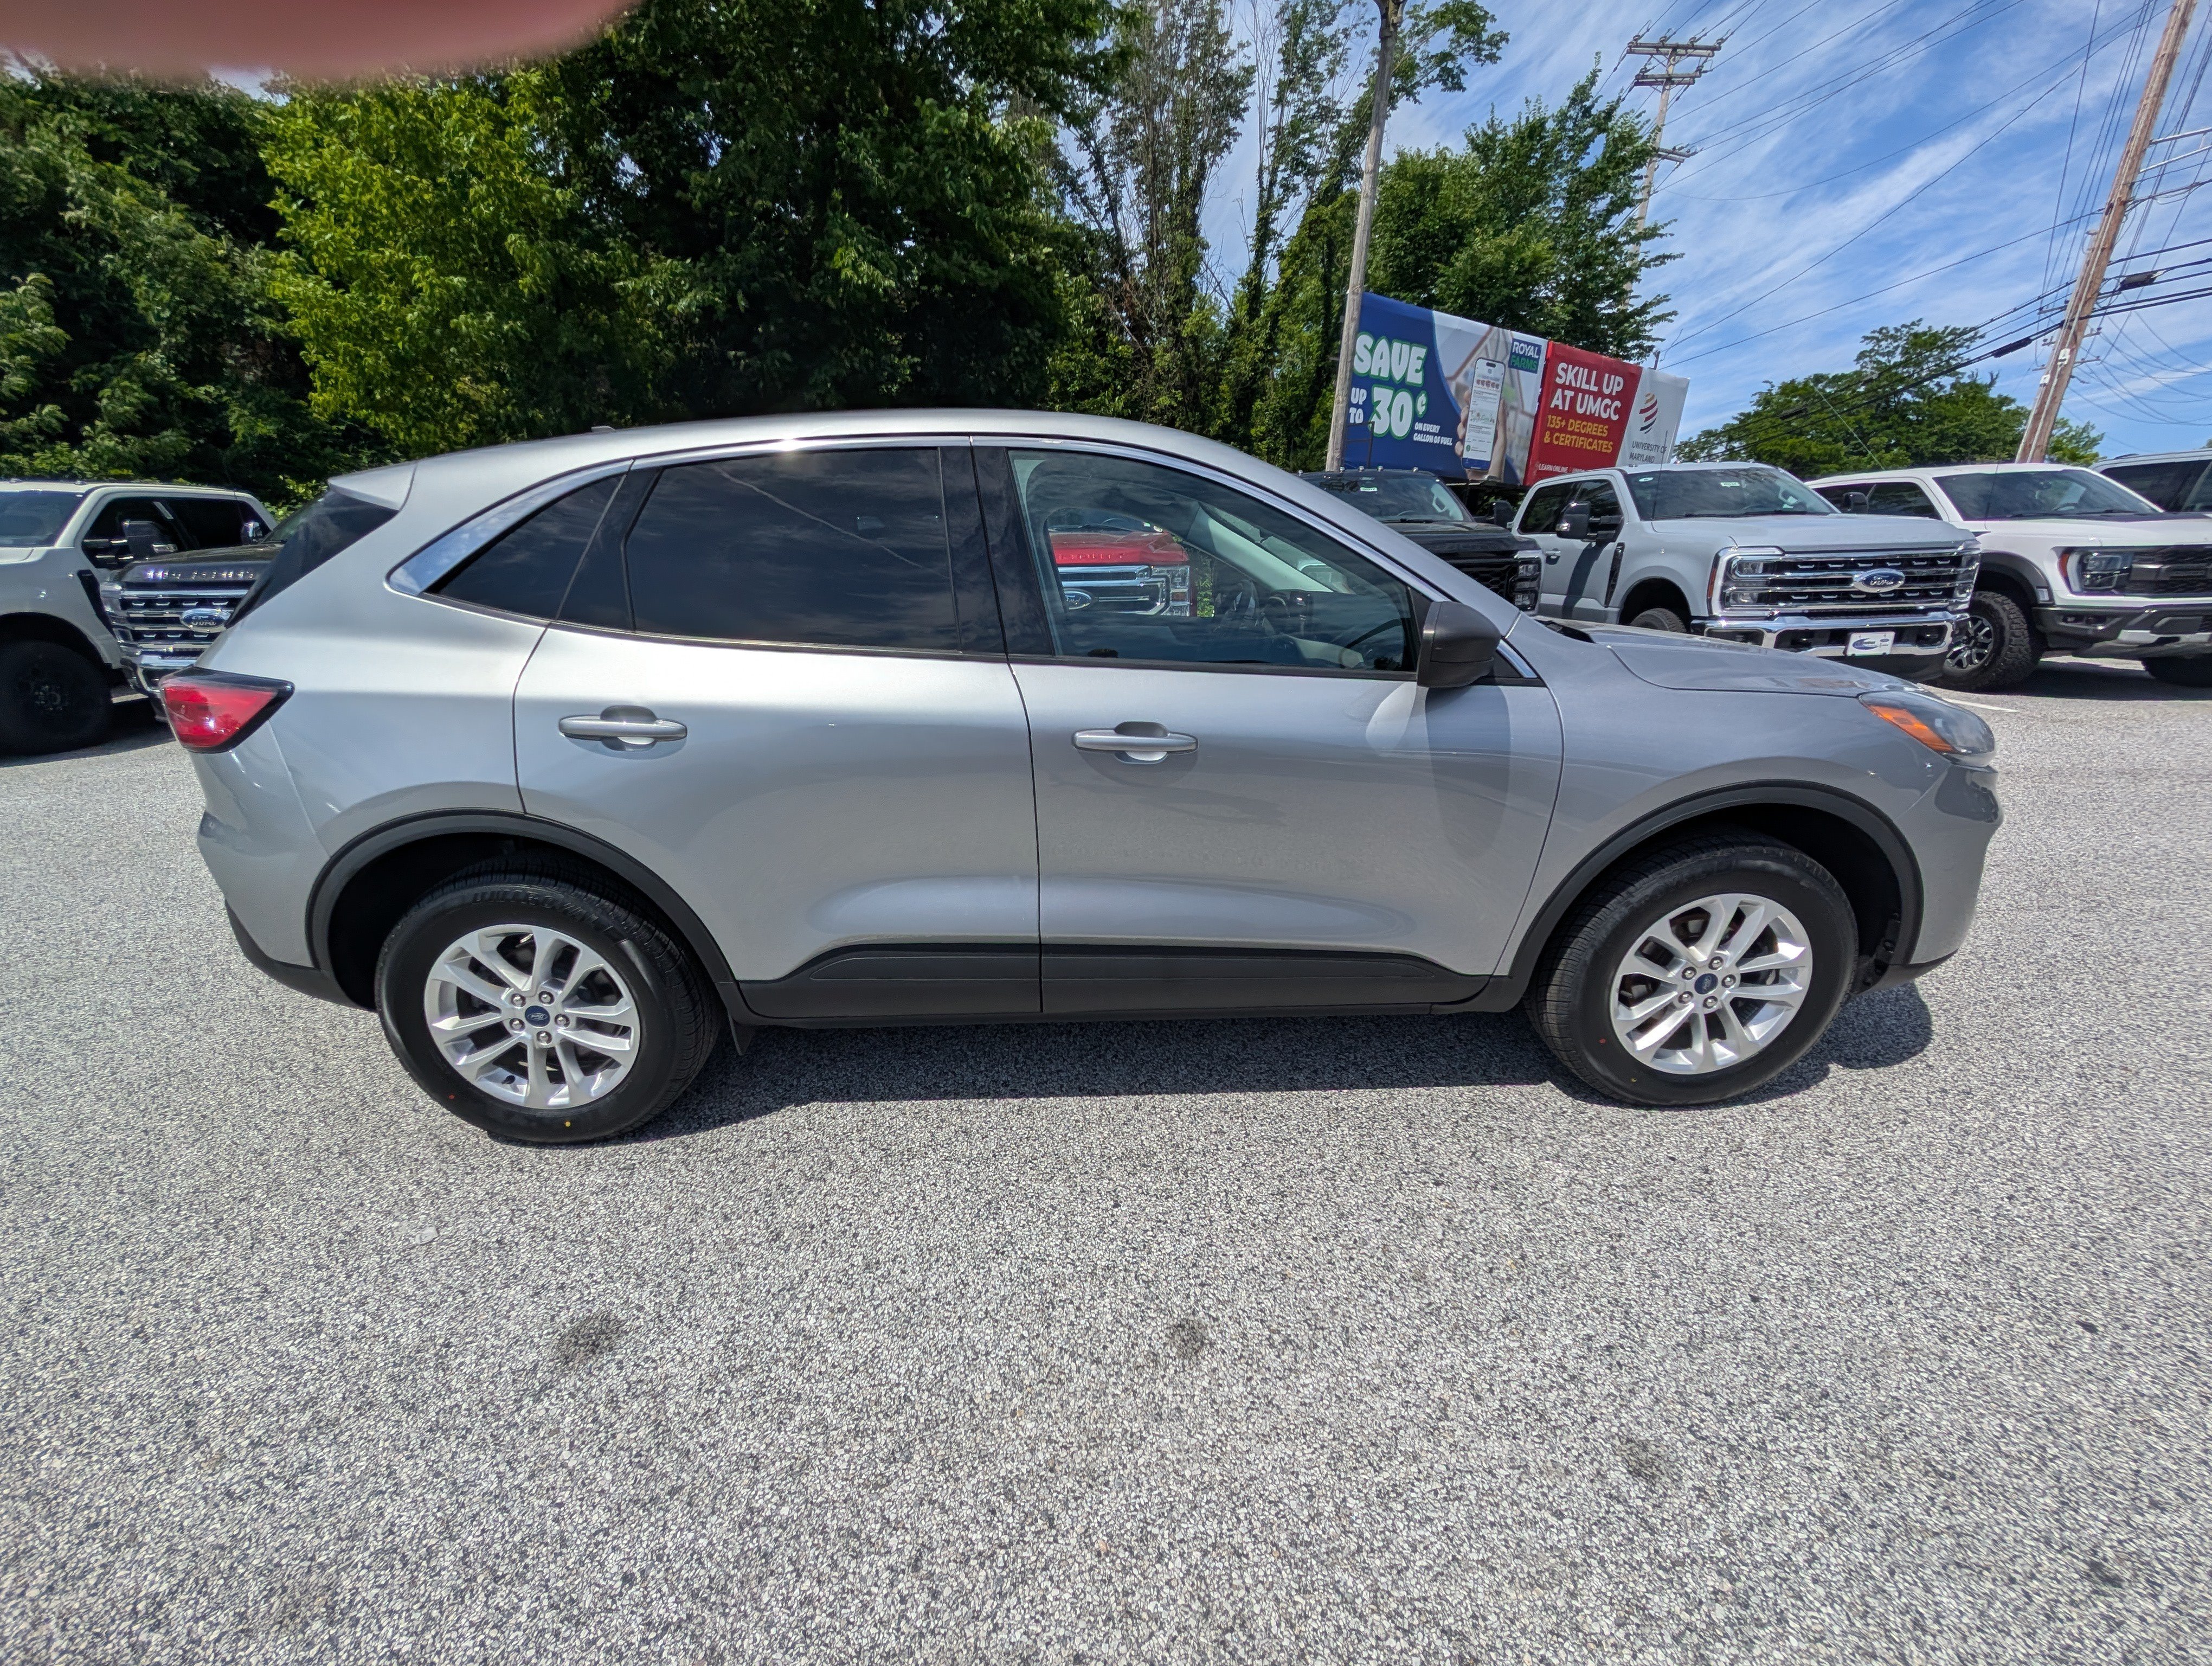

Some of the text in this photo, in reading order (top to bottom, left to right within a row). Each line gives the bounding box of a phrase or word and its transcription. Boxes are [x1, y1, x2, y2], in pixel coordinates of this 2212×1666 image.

[1512, 341, 1539, 358] ROYAL
[1353, 332, 1427, 386] SAVE
[1510, 355, 1538, 371] FARMS
[1555, 362, 1624, 396] SKILL UP
[1351, 387, 1367, 405] UP
[1550, 388, 1622, 421] AT UMGC
[1349, 407, 1364, 424] TO
[1414, 422, 1441, 433] ON EVERY
[1547, 415, 1609, 437] 135+ DEGREES
[1413, 433, 1453, 446] GALLON OF FUEL
[1544, 431, 1613, 453] & CERTIFICATES
[1632, 440, 1661, 452] UNIVERSITY
[1629, 452, 1655, 464] MARYLAND
